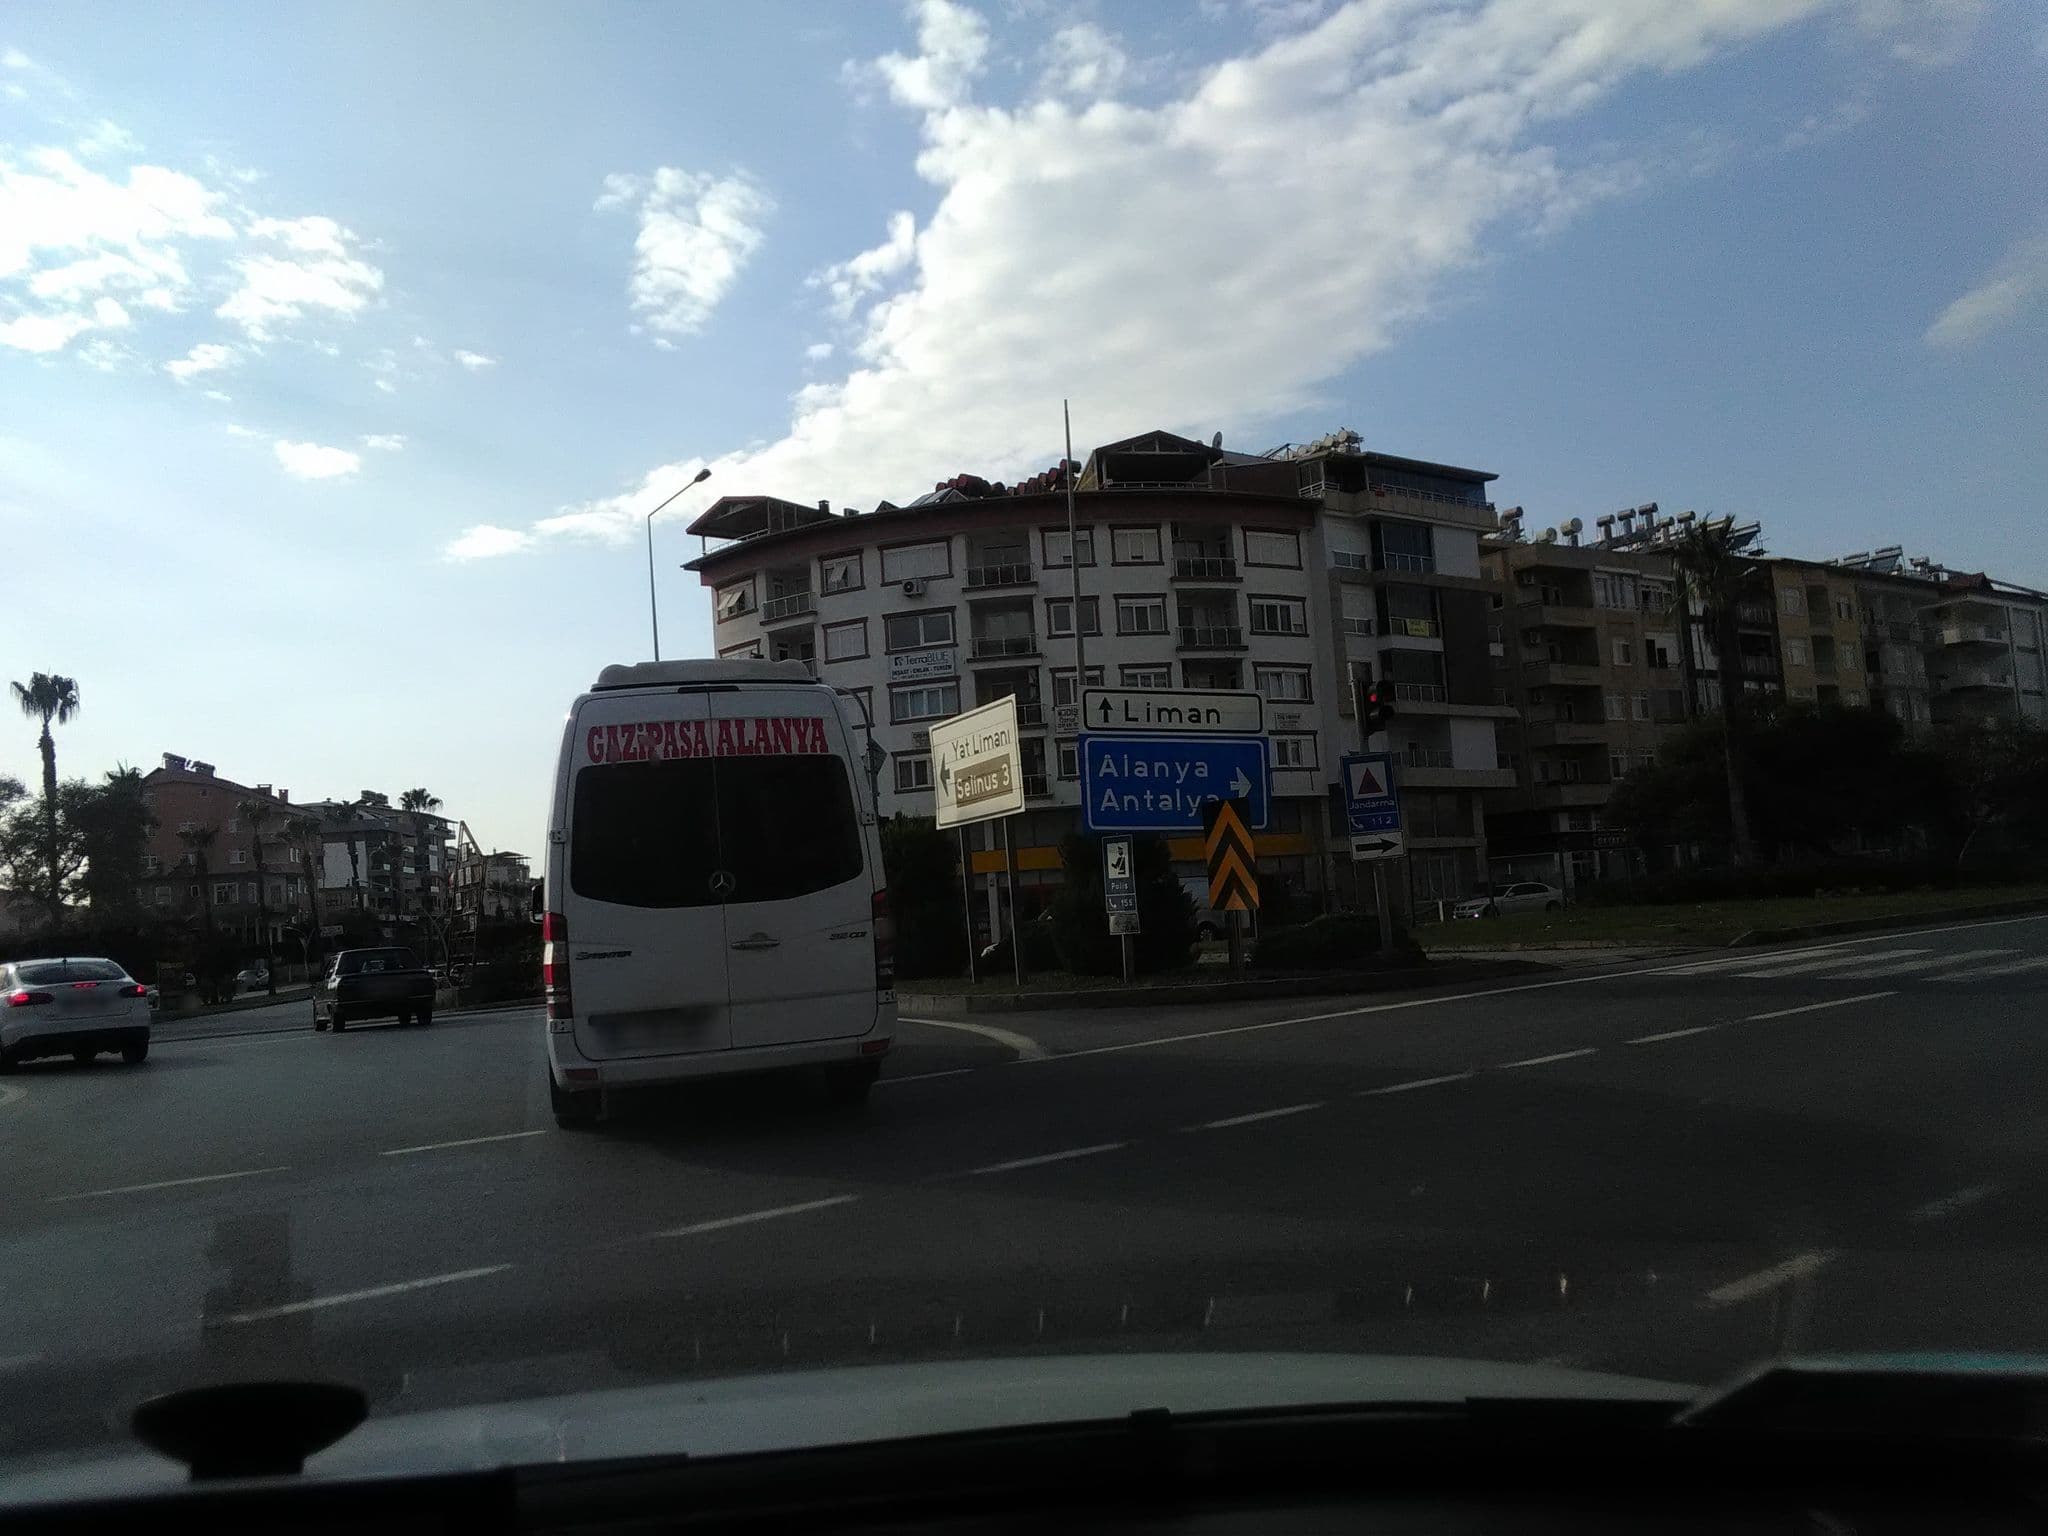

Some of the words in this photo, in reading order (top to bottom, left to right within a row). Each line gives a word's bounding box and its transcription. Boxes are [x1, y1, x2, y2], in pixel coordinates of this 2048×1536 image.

[1124, 700, 1221, 724] Liman
[716, 718, 829, 756] ALANYA
[952, 739, 971, 760] Yat
[973, 729, 1011, 755] Limanı
[956, 772, 999, 799] Selinus
[1001, 763, 1010, 786] 3
[1098, 755, 1209, 784] Alanya
[1349, 799, 1395, 810] Jandarma
[1371, 816, 1393, 825] 112
[1111, 882, 1129, 890] Polis
[1121, 898, 1133, 907] 155
